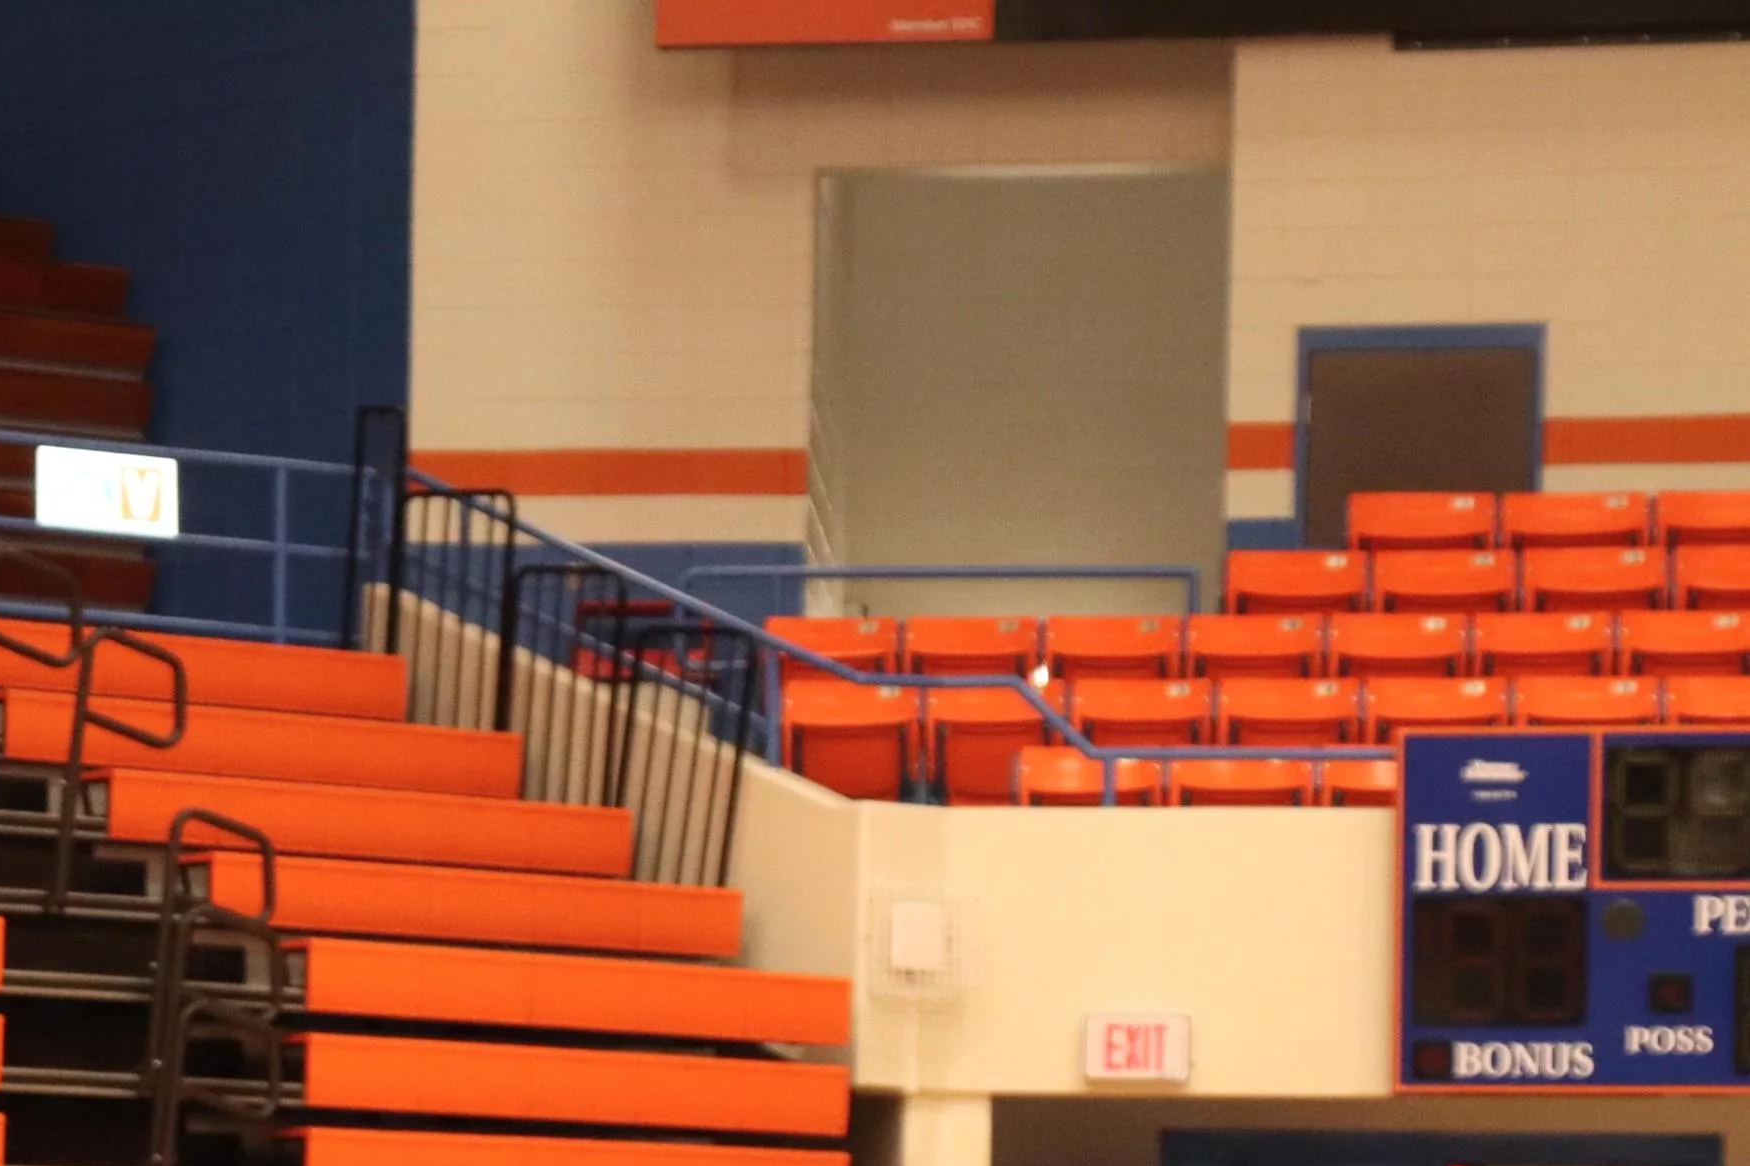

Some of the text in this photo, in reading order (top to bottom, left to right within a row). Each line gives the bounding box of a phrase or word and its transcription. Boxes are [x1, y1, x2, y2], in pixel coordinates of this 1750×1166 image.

[1415, 823, 1587, 891] HOME
[1105, 1024, 1168, 1071] EXIT
[1453, 1041, 1595, 1078] BONUS
[1625, 1025, 1714, 1054] POSS
